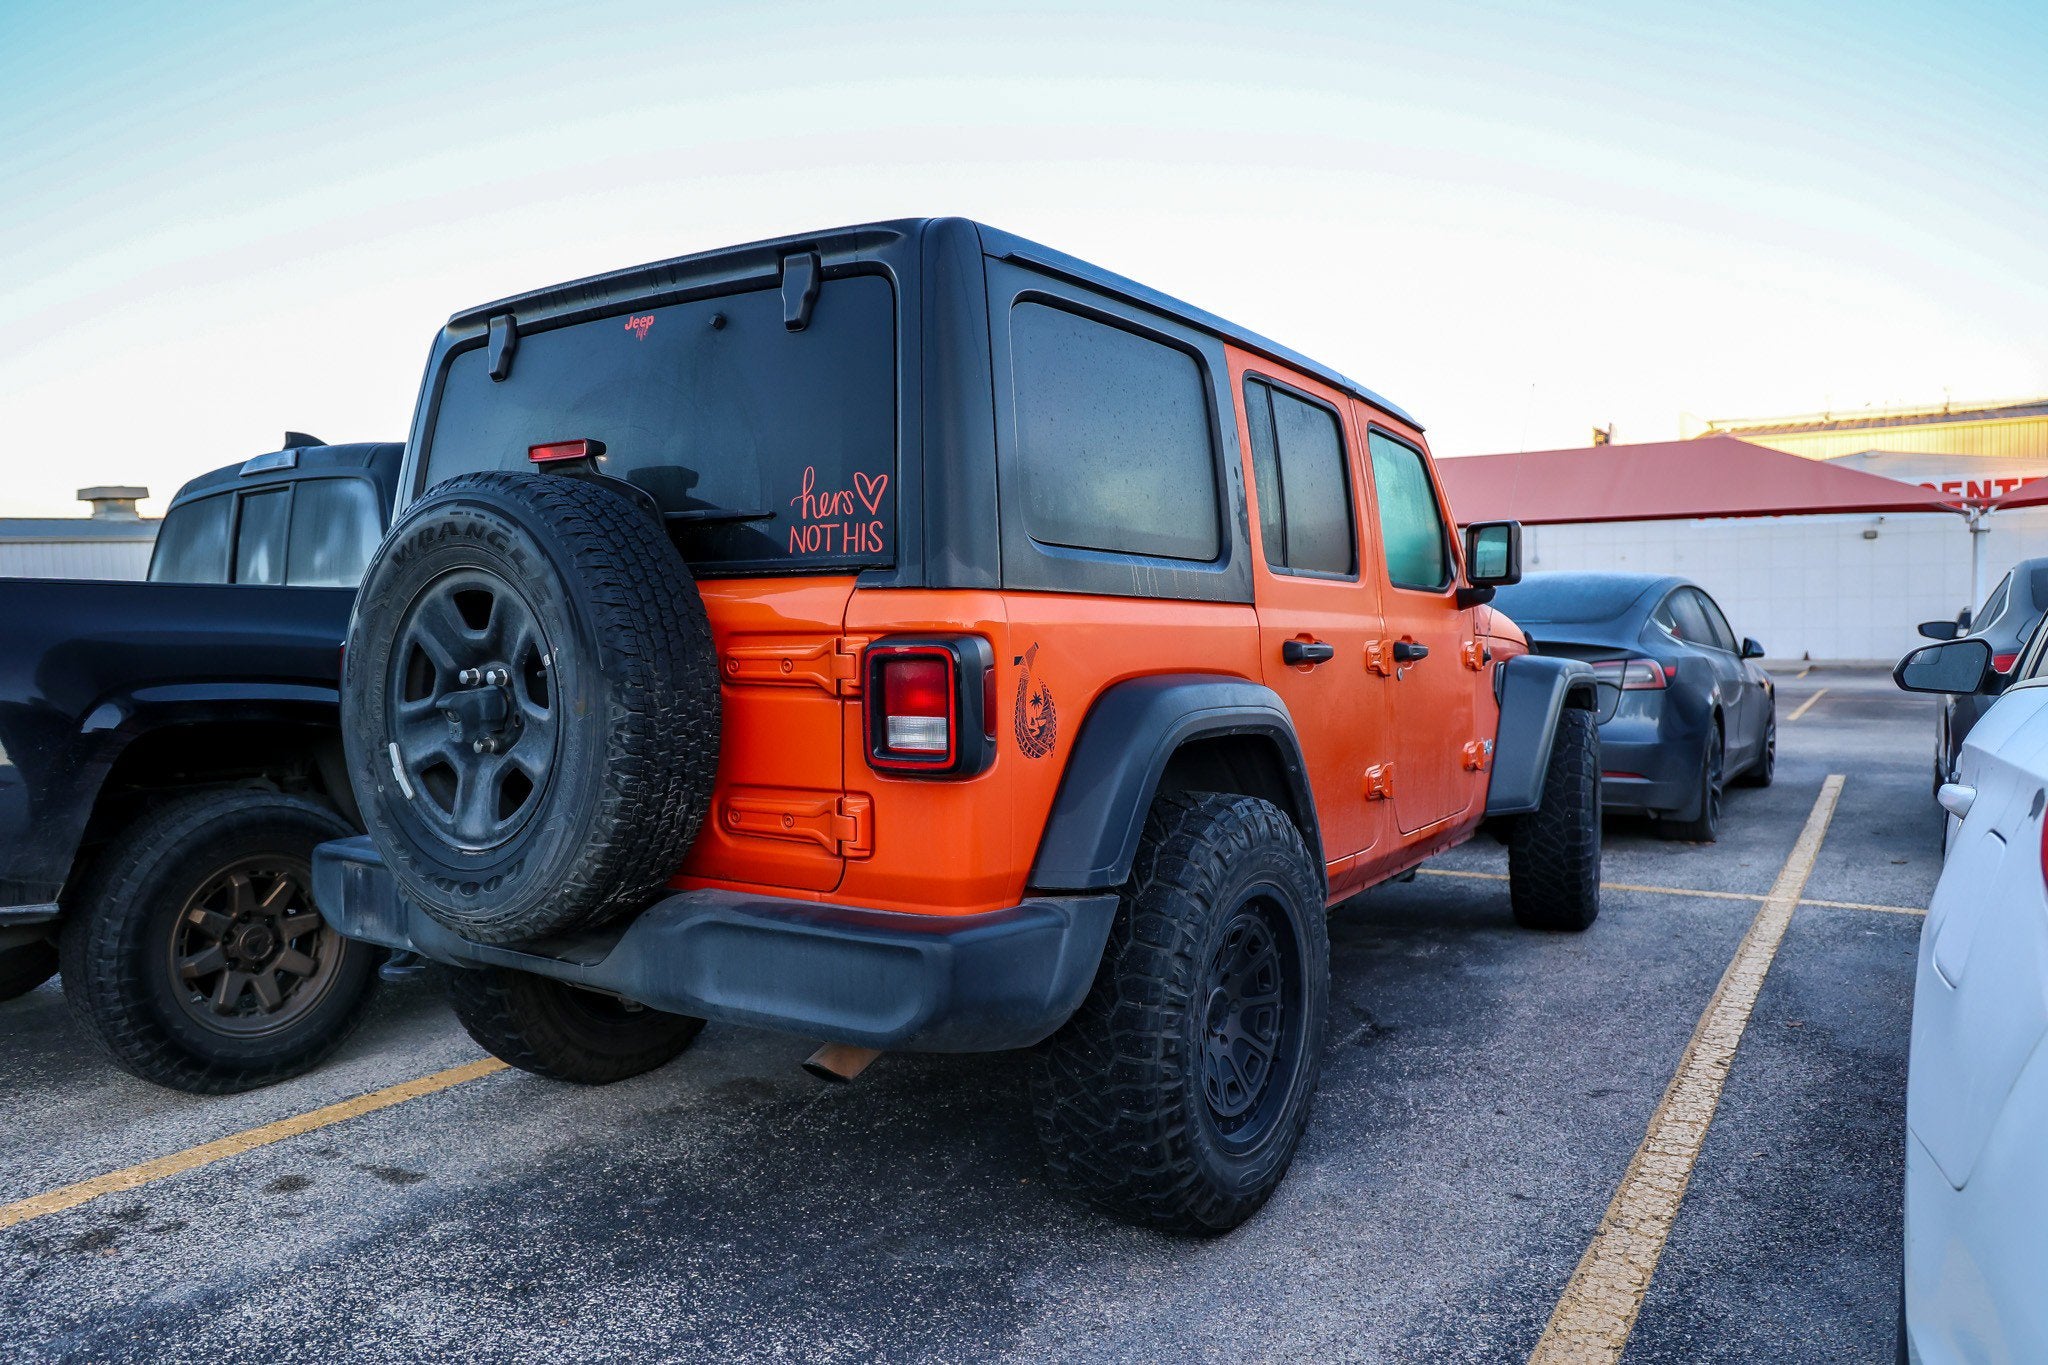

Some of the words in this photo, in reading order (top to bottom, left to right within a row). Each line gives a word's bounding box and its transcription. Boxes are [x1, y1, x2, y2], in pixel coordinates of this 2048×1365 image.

[624, 315, 655, 330] Jeep
[790, 466, 854, 519] hers
[1919, 478, 2042, 509] ENT
[788, 524, 840, 554] NOT
[842, 520, 884, 554] HIS
